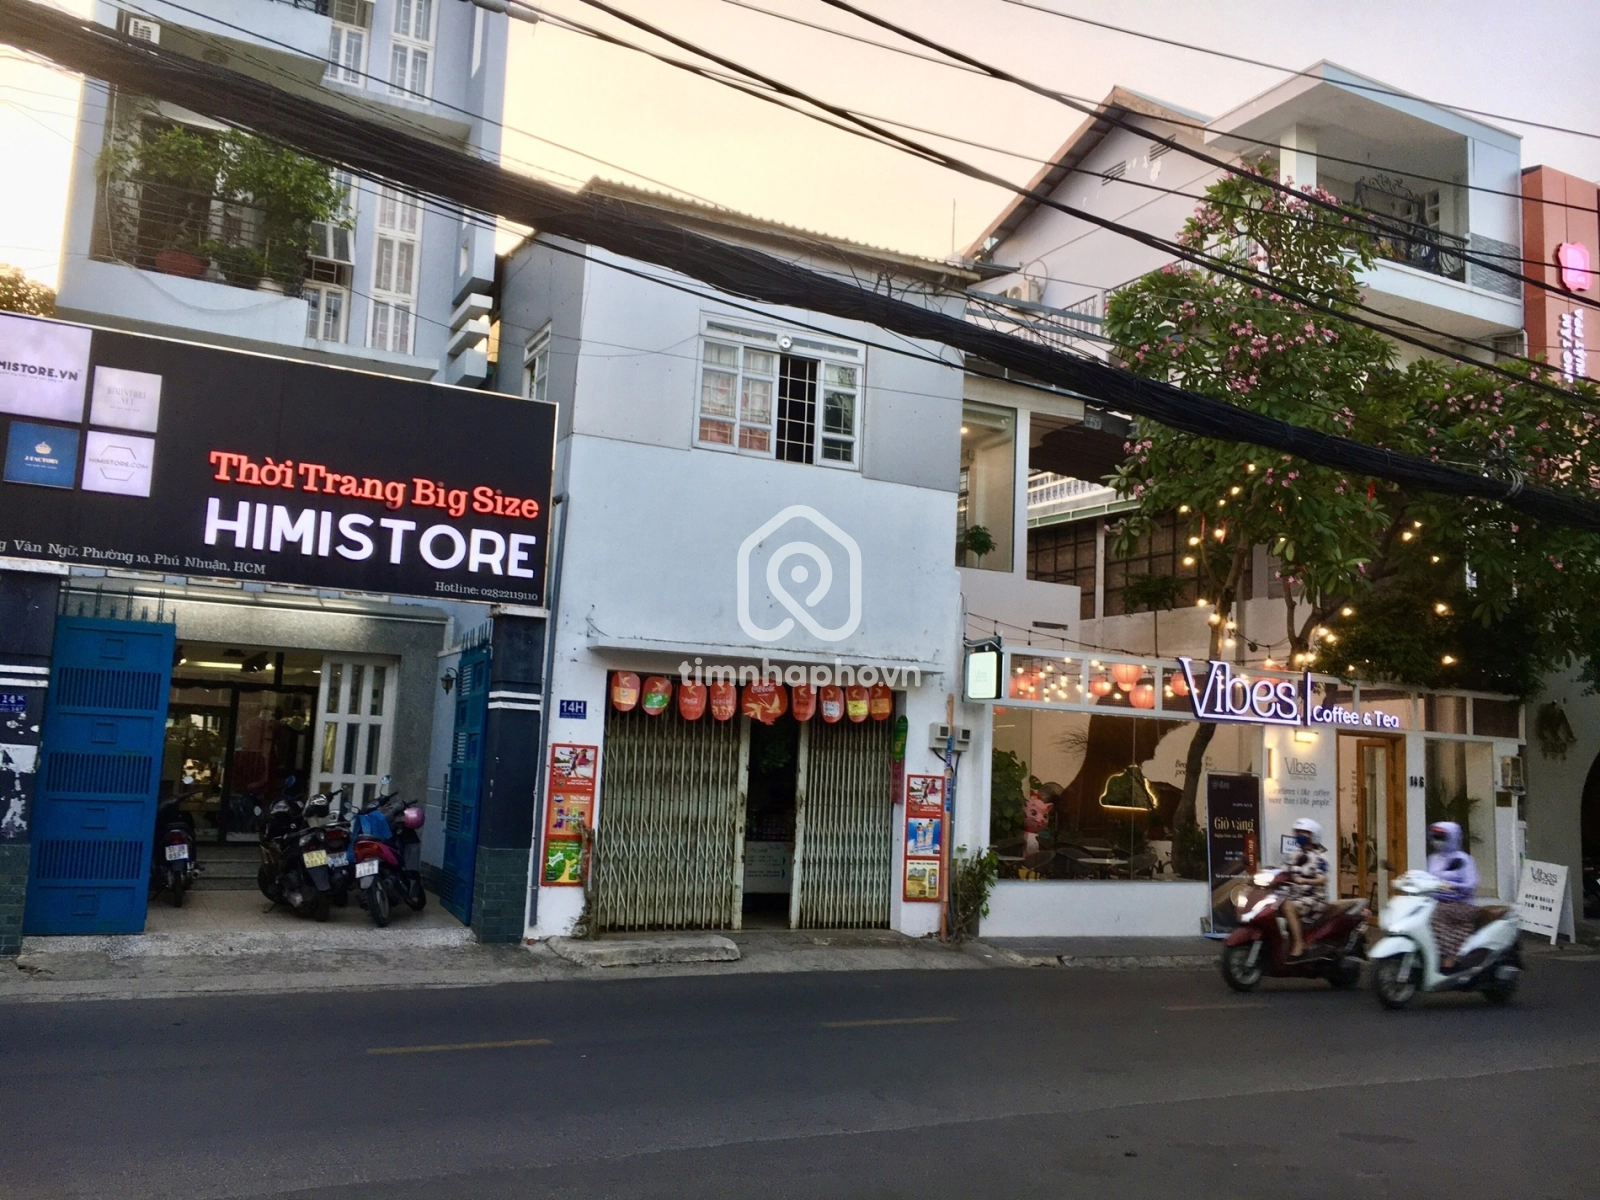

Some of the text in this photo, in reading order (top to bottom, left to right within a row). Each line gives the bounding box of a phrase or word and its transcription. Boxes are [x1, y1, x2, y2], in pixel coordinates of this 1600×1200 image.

[209, 450, 540, 519] Thời Trang Big Size
[204, 496, 537, 579] HIMISTORE
[82, 546, 134, 564] Phường
[154, 553, 180, 566] Phú
[233, 561, 267, 575] HCM
[434, 581, 539, 601] Hotline: 02822119110
[1179, 657, 1400, 728] Vibes Coffee & Tea
[561, 700, 585, 713] 14H
[1284, 757, 1317, 776] Vibes
[1525, 893, 1538, 901] OPEN
